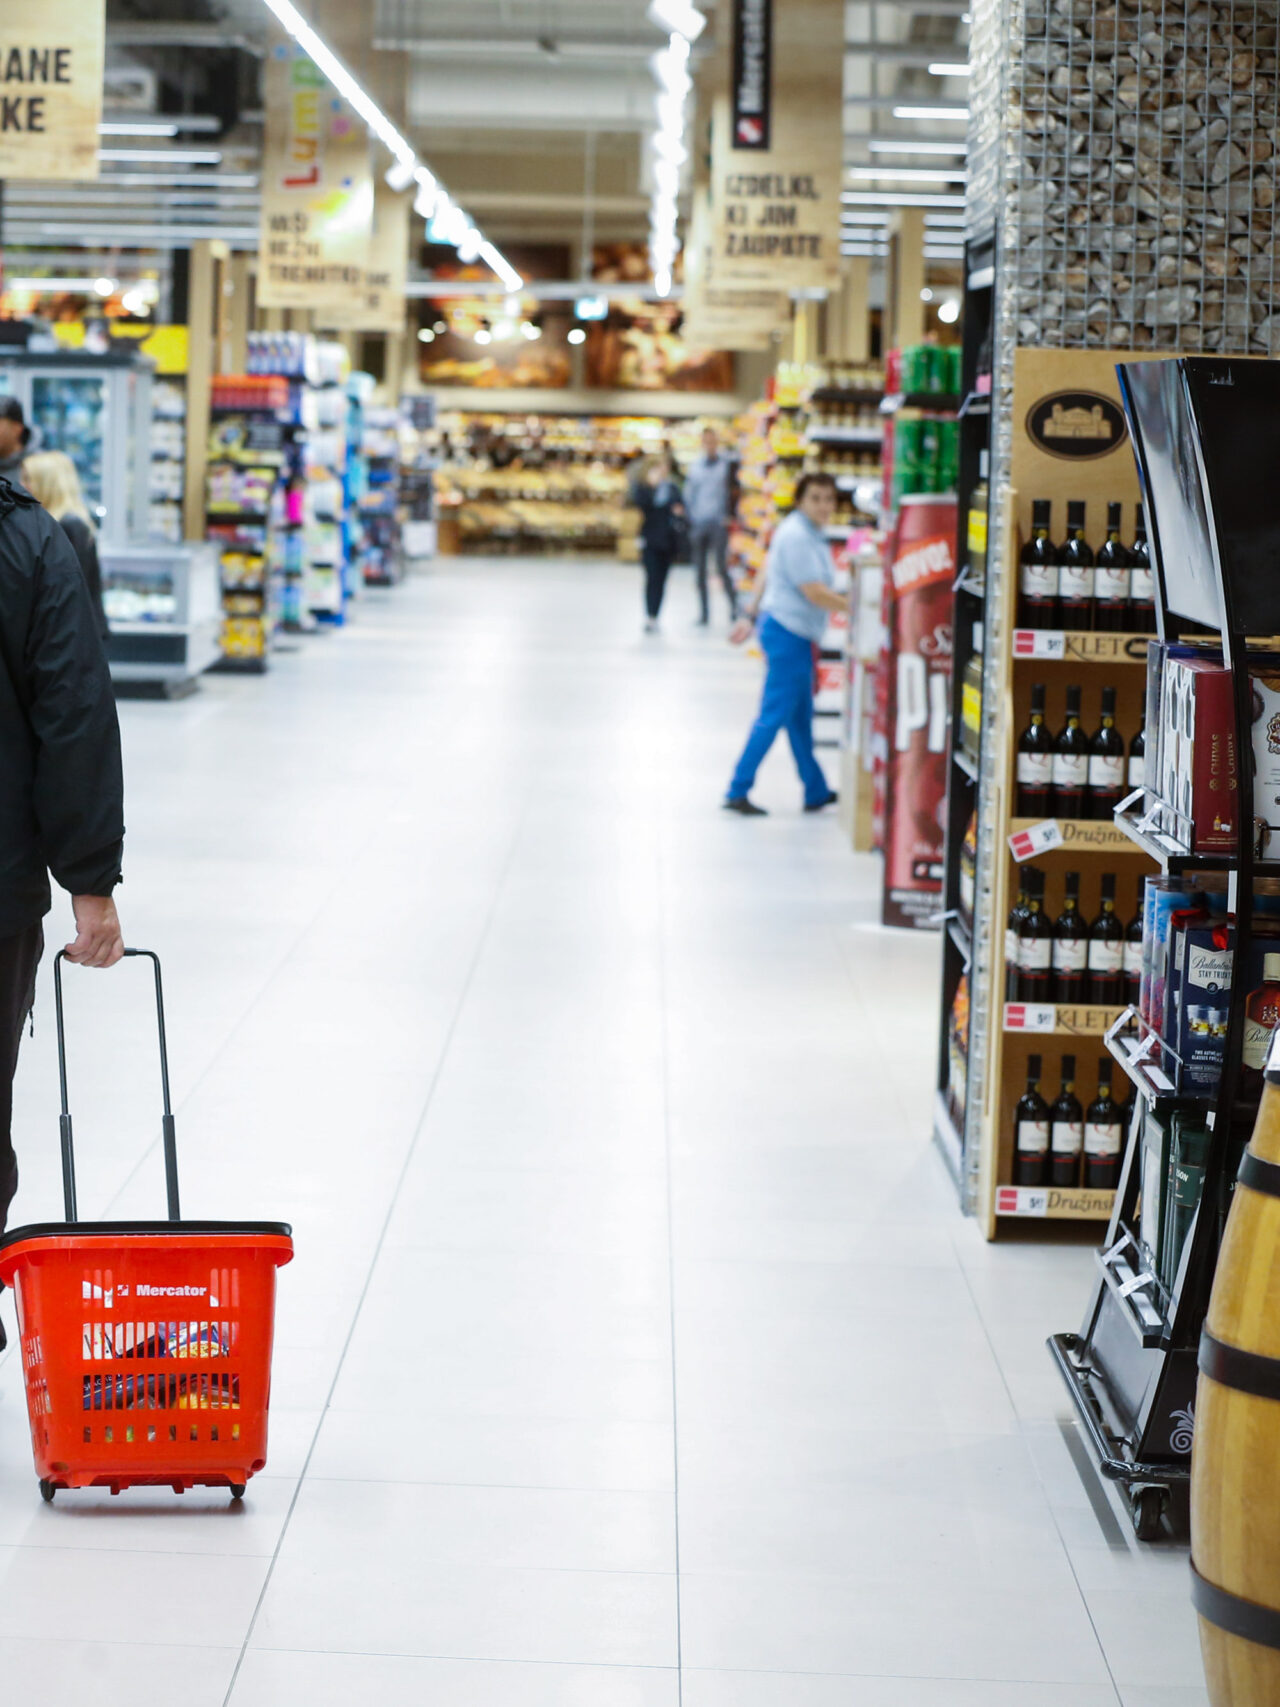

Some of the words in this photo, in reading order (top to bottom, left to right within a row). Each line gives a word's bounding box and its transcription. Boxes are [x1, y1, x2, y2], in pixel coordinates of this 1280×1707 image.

[1210, 733, 1220, 775] CHIVAS
[1198, 969, 1212, 978] STAY
[136, 1284, 207, 1297] Mercator
